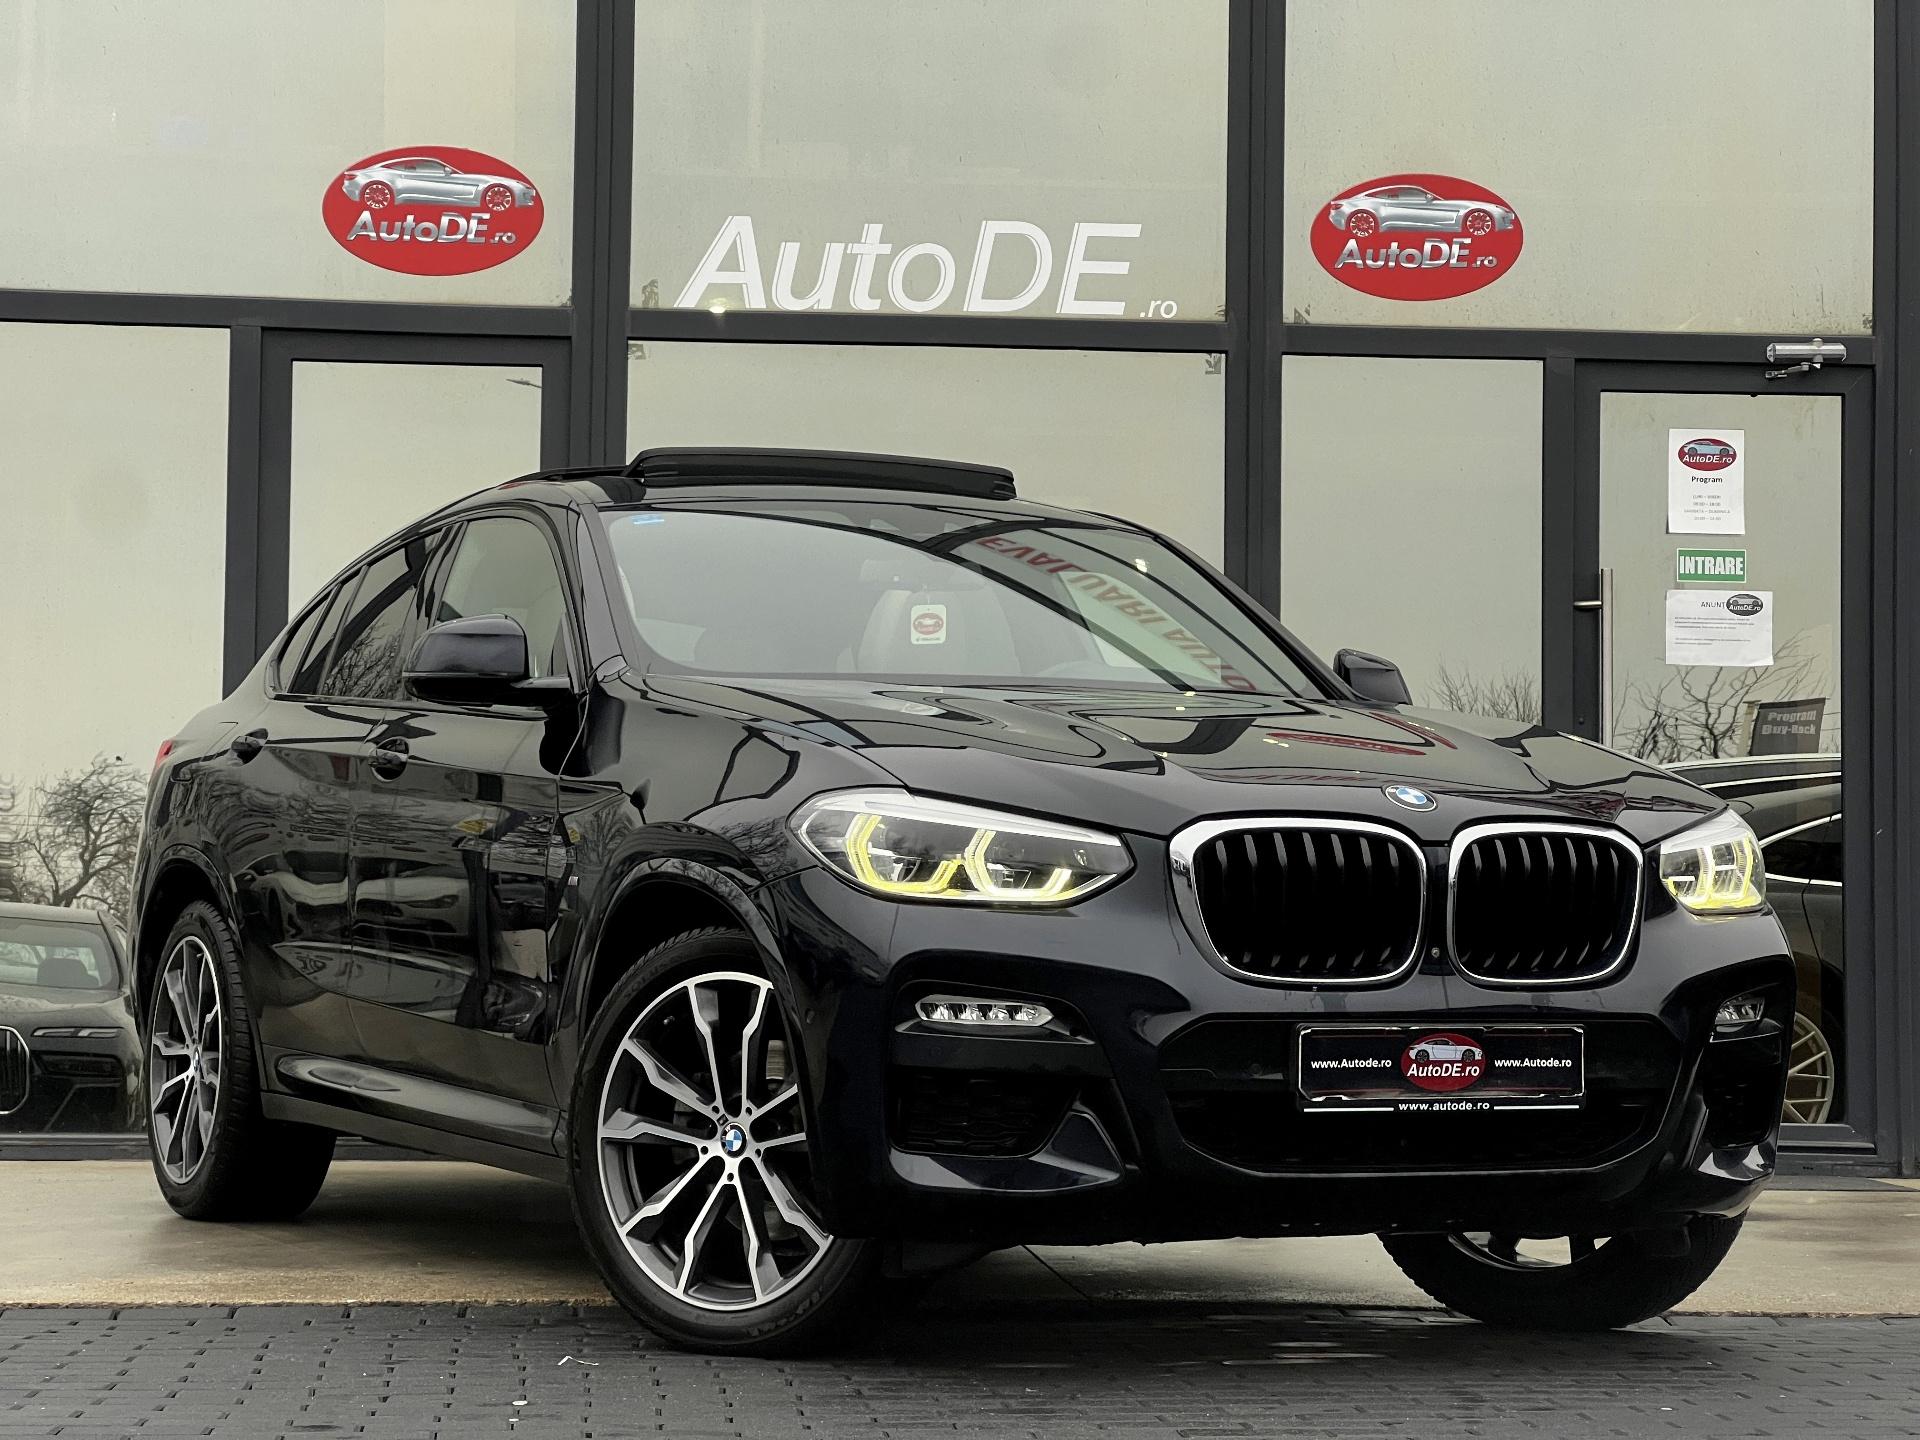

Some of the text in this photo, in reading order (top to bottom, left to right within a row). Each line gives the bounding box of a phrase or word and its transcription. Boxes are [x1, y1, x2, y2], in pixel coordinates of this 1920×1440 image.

[1682, 454, 1733, 464] AutoDE.ro
[1691, 476, 1723, 484] Program
[1679, 556, 1744, 575] INTRARE
[1311, 1058, 1392, 1069] www.Autode.ro
[1494, 1057, 1572, 1068] www.Autode.ro
[1407, 1063, 1480, 1077] AutoDE.ro
[1398, 1101, 1490, 1111] www.autode.ro
